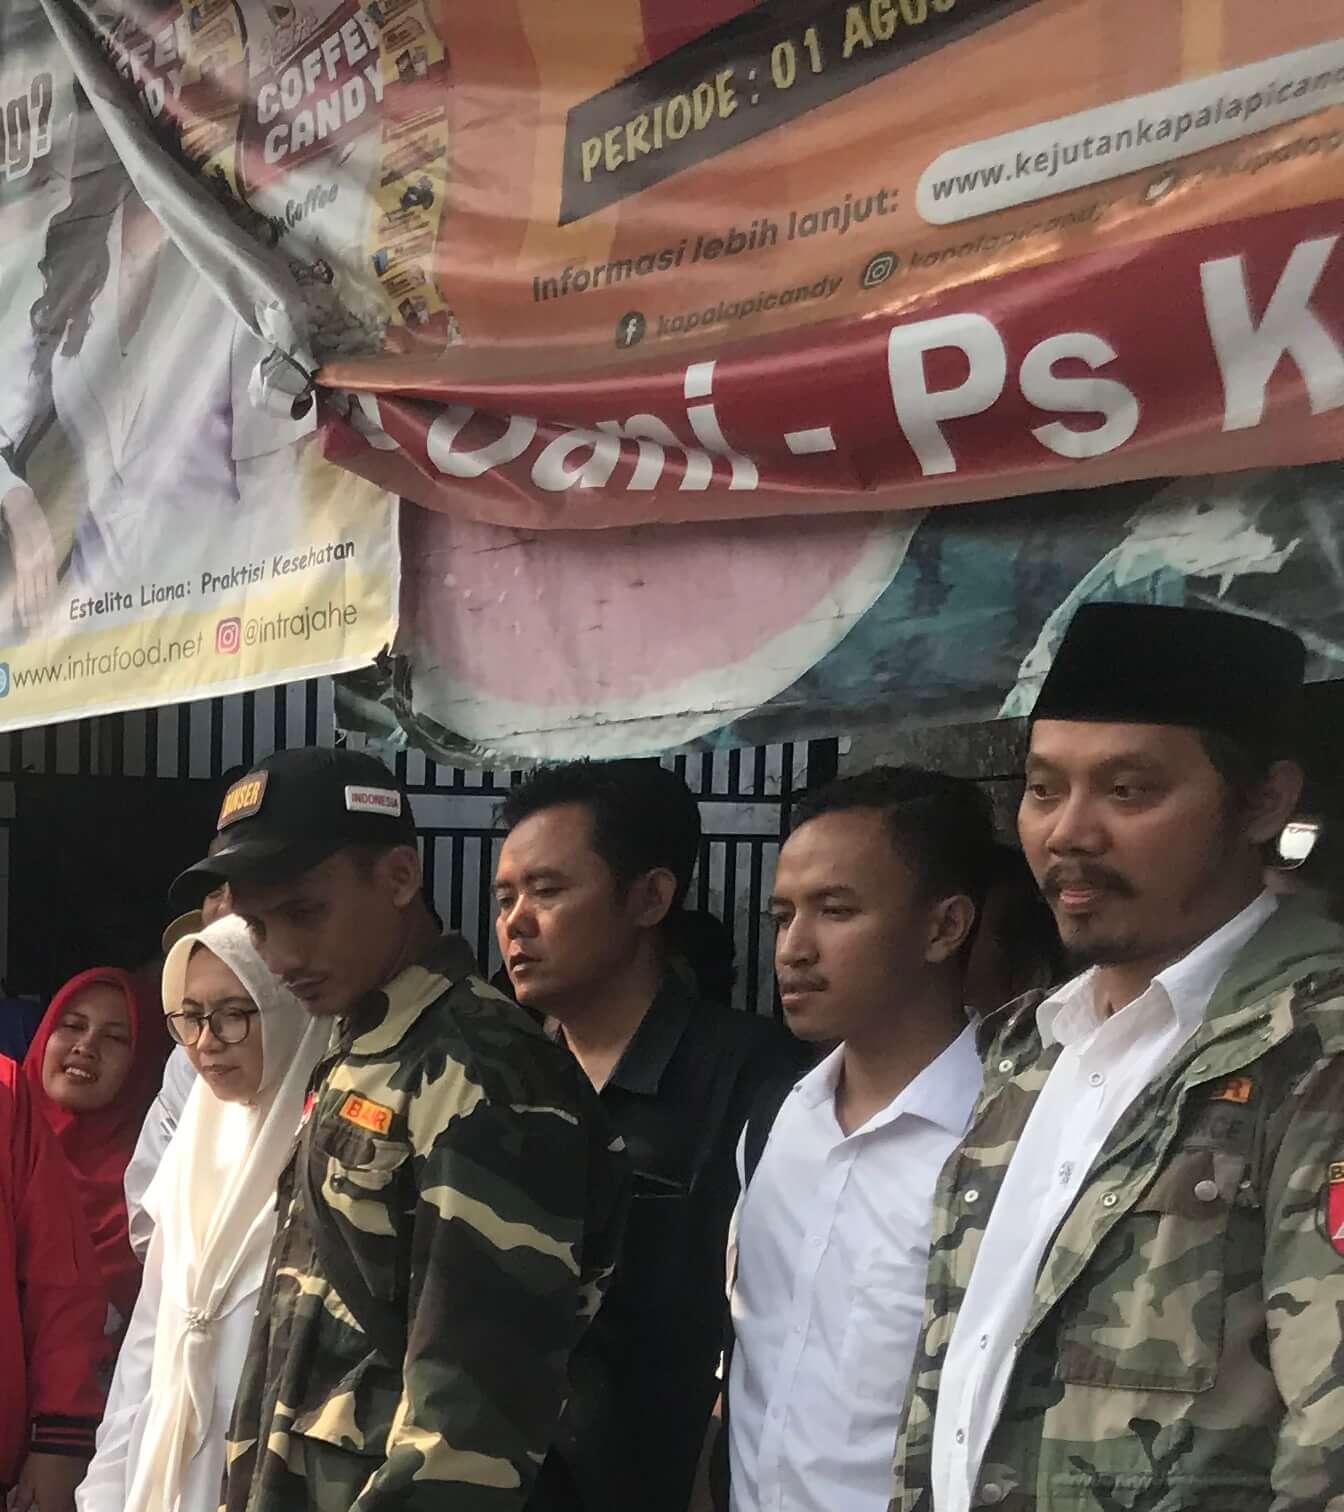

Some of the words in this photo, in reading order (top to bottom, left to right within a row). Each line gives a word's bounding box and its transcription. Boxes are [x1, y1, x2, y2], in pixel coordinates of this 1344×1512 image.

[264, 58, 384, 164] CANDY
[581, 67, 739, 183] PERIODE
[770, 27, 825, 89] 01
[532, 237, 688, 303] Informasi
[692, 220, 779, 263] lebih
[787, 186, 902, 241] lanjut:
[656, 274, 845, 338] kapalapicandy
[887, 312, 1141, 477] Ps
[69, 591, 134, 622] Estelita
[140, 578, 192, 609] Liana:
[200, 565, 266, 596] Praktisi
[271, 540, 356, 578] Kesehatan
[12, 631, 204, 689] www.intrafood.net
[244, 600, 359, 646] @intrajahe
[350, 792, 399, 808] INDONESIA
